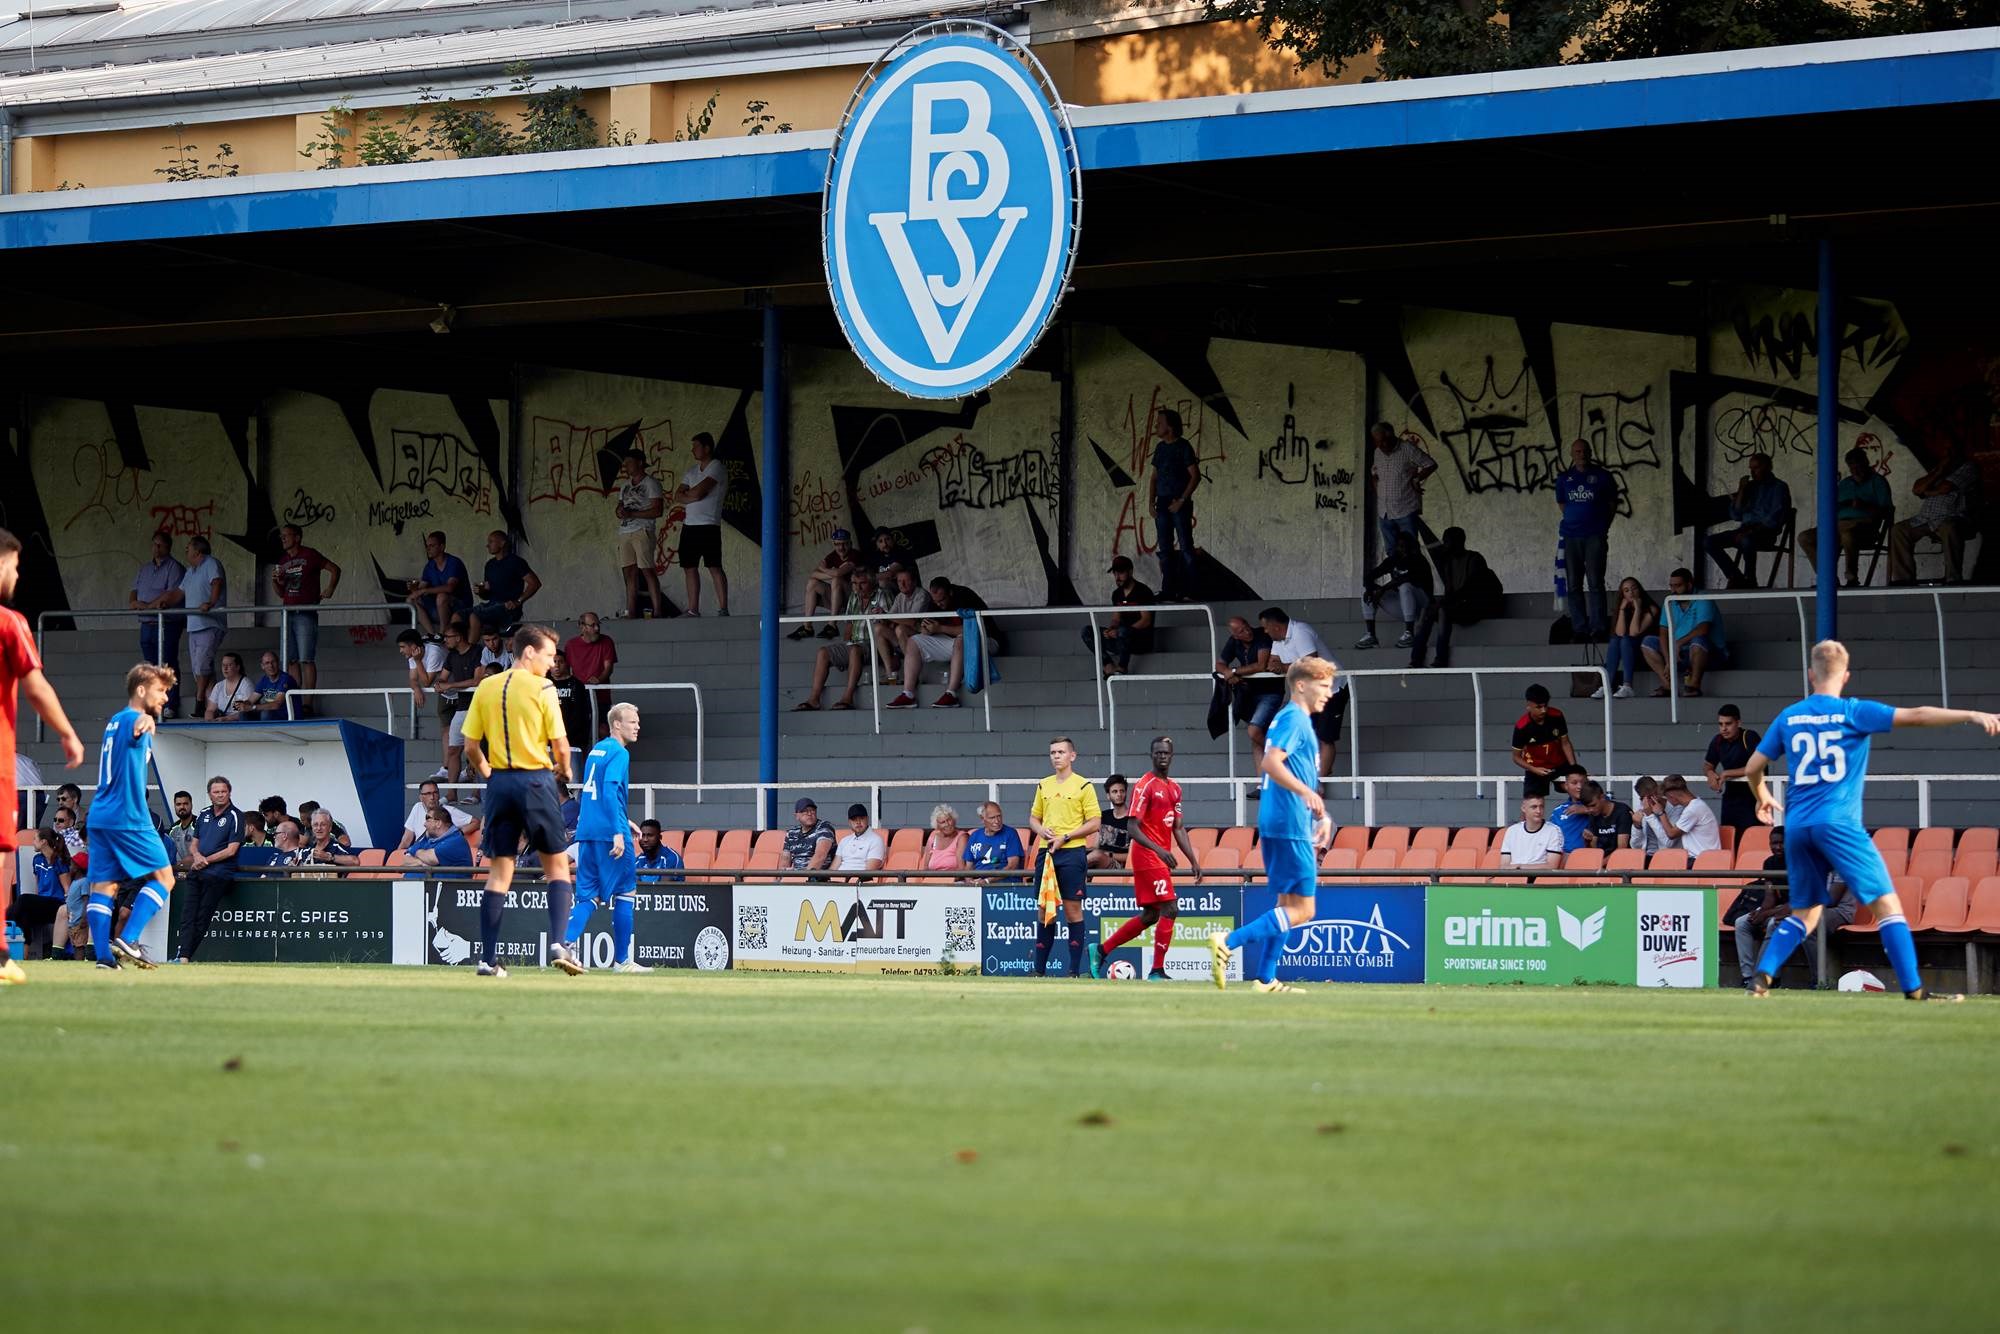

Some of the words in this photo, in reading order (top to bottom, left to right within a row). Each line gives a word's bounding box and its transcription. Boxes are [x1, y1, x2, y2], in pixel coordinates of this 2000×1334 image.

[1791, 730, 1846, 786] 25
[582, 762, 597, 801] 4
[1153, 879, 1168, 895] 22
[521, 891, 549, 909] CRA
[654, 894, 676, 911] BEI
[678, 895, 710, 912] UNS.
[1199, 892, 1222, 911] als
[211, 910, 276, 923] ROBERT
[281, 912, 296, 923] C.
[300, 911, 349, 923] SPIES
[794, 899, 918, 943] MATT
[318, 931, 348, 939] SEIT
[355, 931, 385, 939] 1919
[1444, 908, 1547, 947] erima
[781, 945, 812, 957] Heizung
[851, 945, 895, 958] Erneuerbare
[897, 946, 931, 957] Energien
[1643, 934, 1687, 952] DUWE
[638, 946, 685, 960] BREMEN
[1277, 954, 1351, 967] IMMOBILIEN
[1165, 961, 1200, 970] SPECHT
[1444, 958, 1498, 970] SPORTSWEAR
[1499, 959, 1524, 970] SINCE
[1526, 960, 1546, 971] 1900
